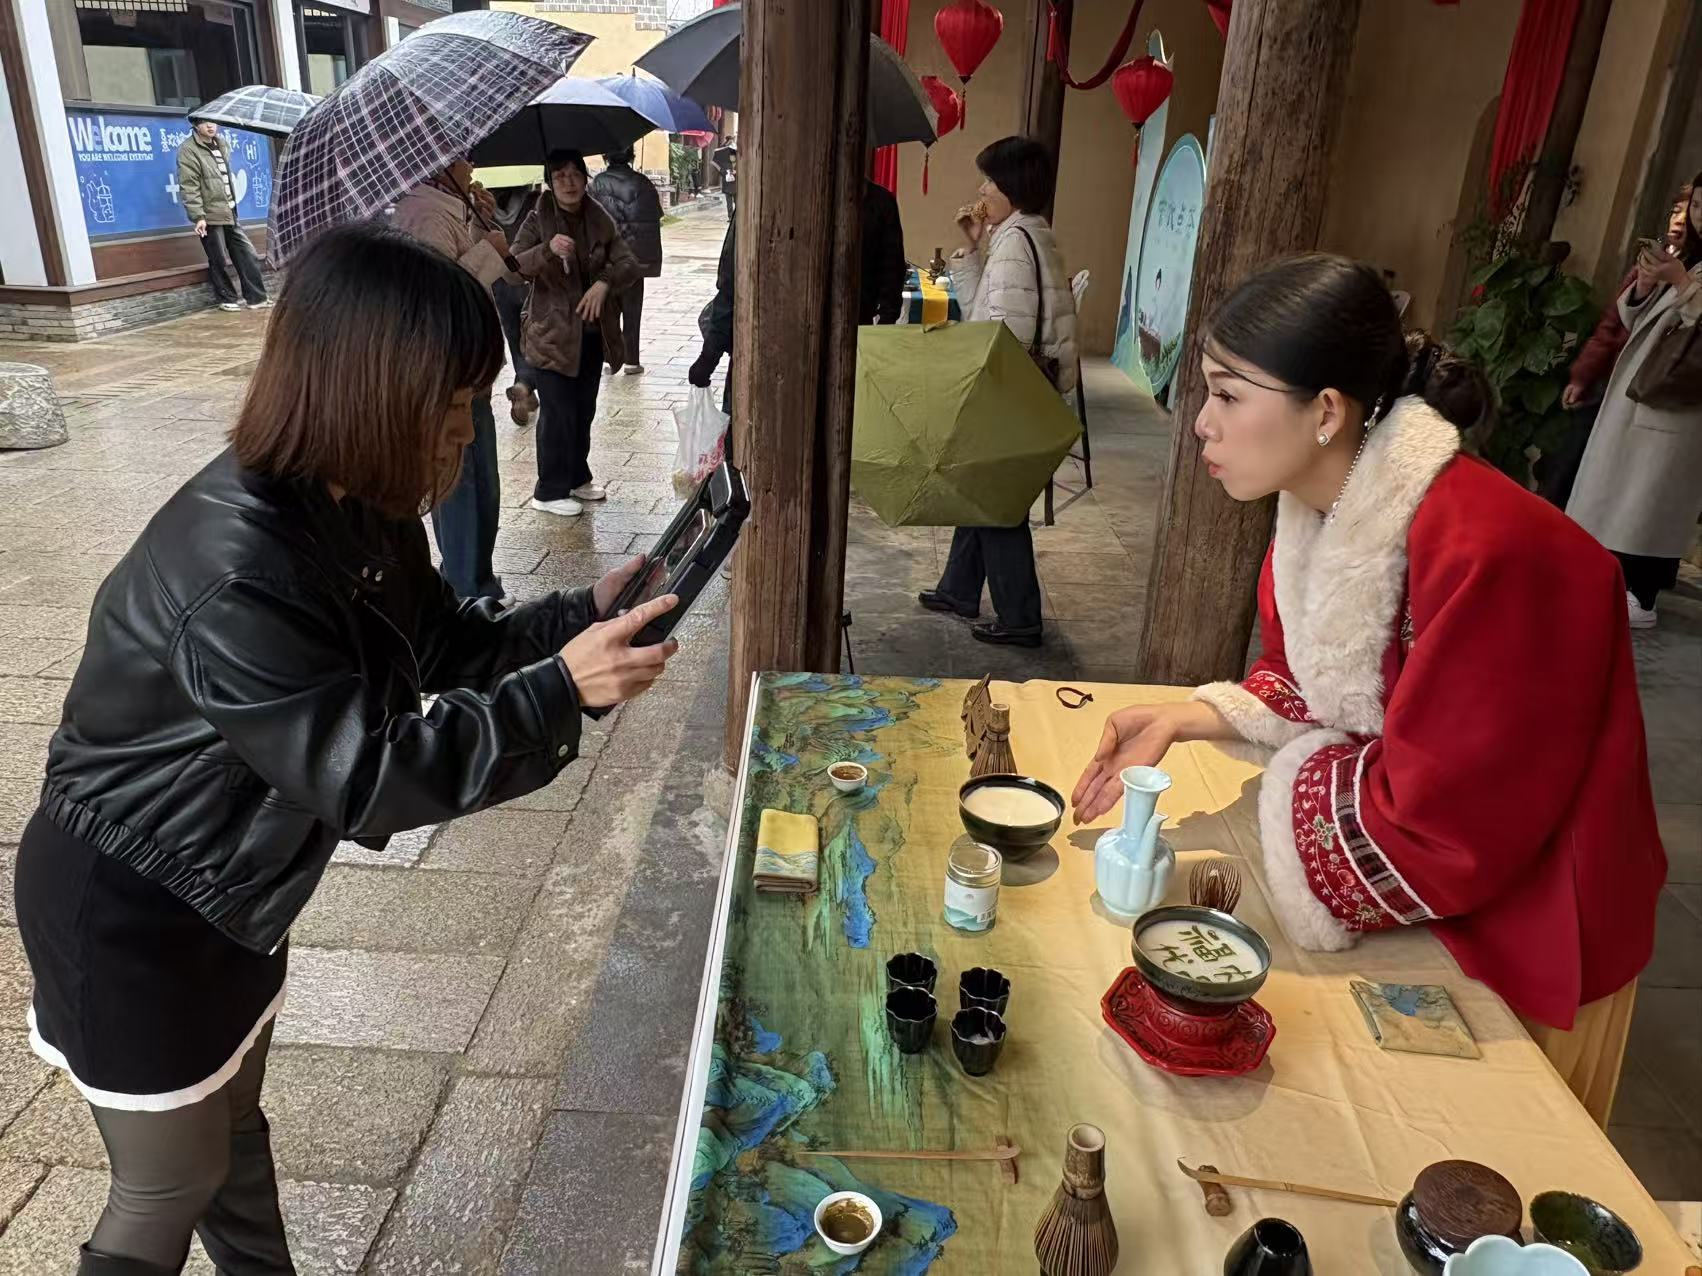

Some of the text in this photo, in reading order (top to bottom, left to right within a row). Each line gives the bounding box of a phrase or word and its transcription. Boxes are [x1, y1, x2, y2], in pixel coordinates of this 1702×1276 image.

[68, 115, 153, 152] Welcome
[78, 153, 91, 162] YOU
[91, 153, 103, 162] ARE
[103, 153, 128, 161] WELCOME
[246, 140, 257, 160] Hi
